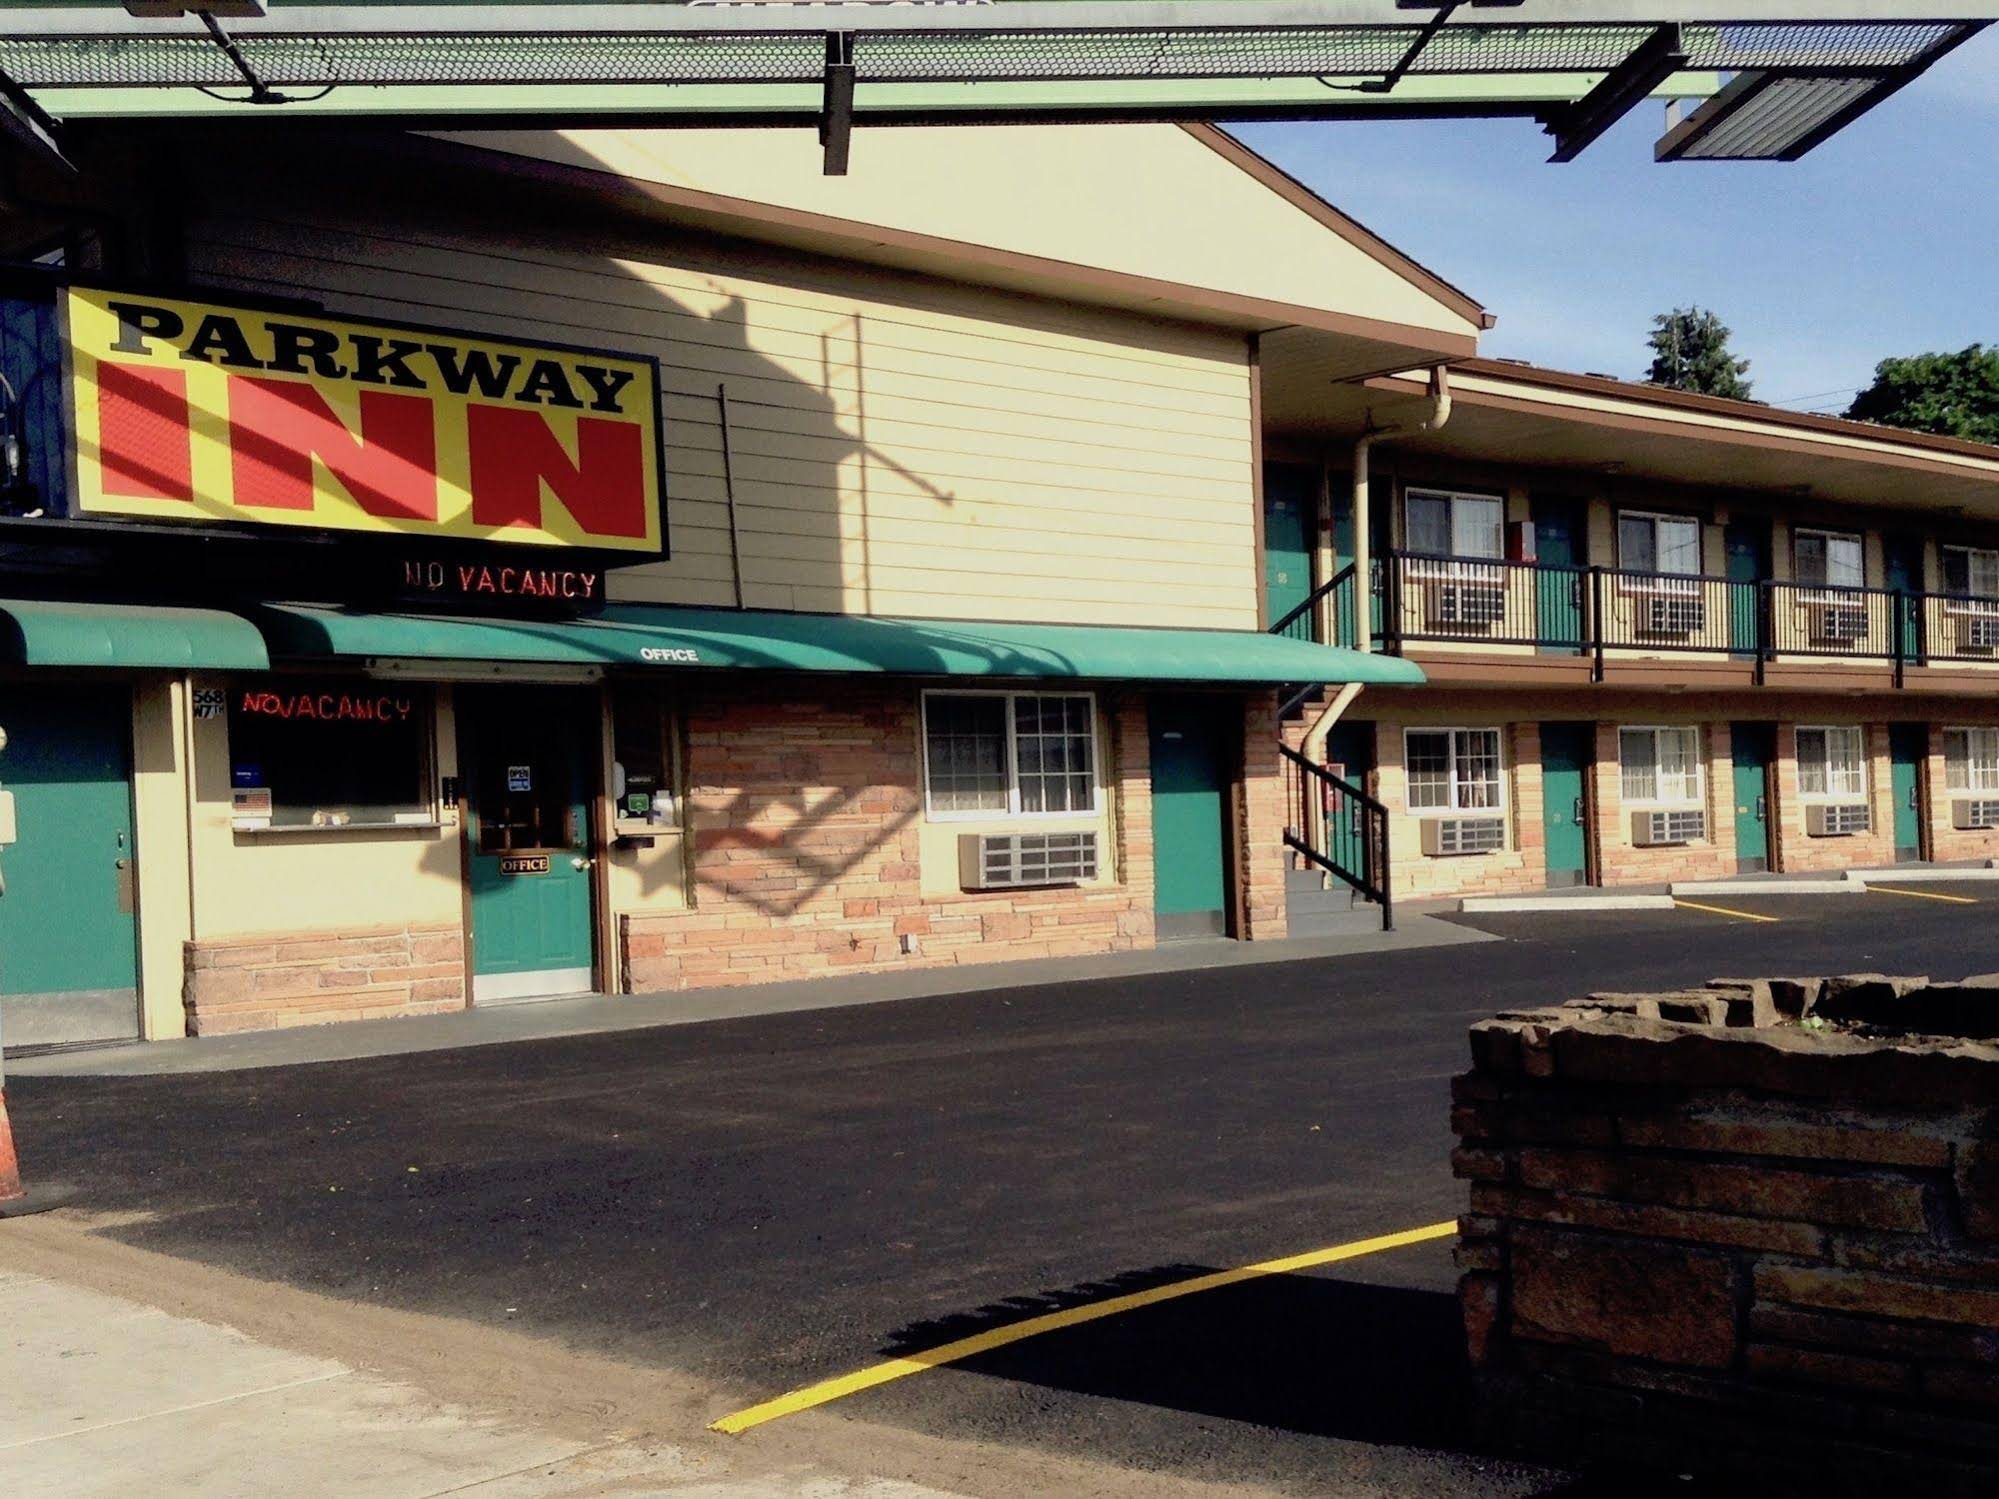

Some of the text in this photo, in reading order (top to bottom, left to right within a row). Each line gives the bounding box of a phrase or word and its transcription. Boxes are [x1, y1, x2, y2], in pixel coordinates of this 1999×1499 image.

[108, 301, 634, 413] PARKWAY
[97, 359, 647, 539] INN
[405, 561, 596, 598] NO VACANCY
[640, 647, 698, 662] OFFICE
[193, 689, 225, 704] 568
[243, 692, 410, 721] NO VACANCY
[502, 859, 548, 871] OFFICE
